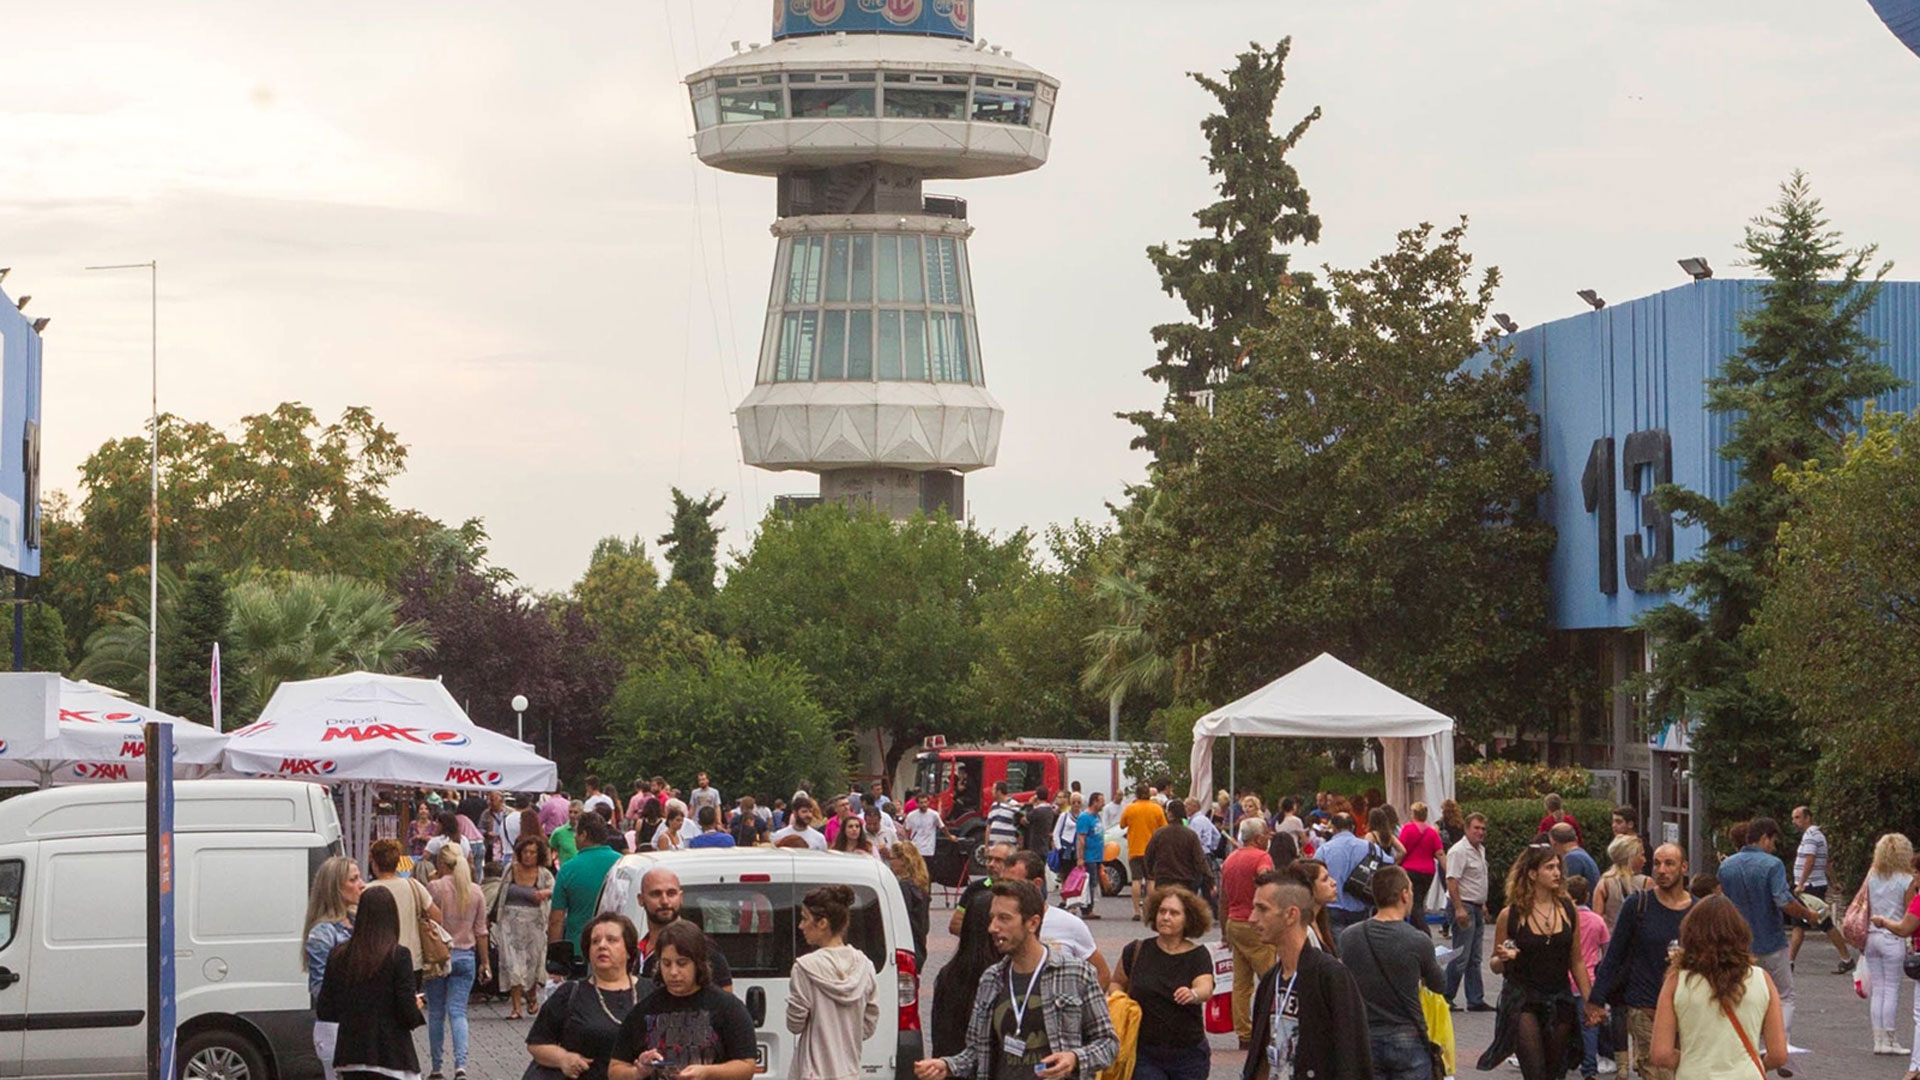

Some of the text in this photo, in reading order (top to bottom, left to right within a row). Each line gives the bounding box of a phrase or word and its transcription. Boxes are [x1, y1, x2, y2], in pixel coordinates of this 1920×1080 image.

[1581, 428, 1675, 595] 13
[321, 724, 428, 744] MAX
[119, 741, 146, 758] MA
[279, 758, 322, 775] MAX
[445, 767, 487, 785] MAX
